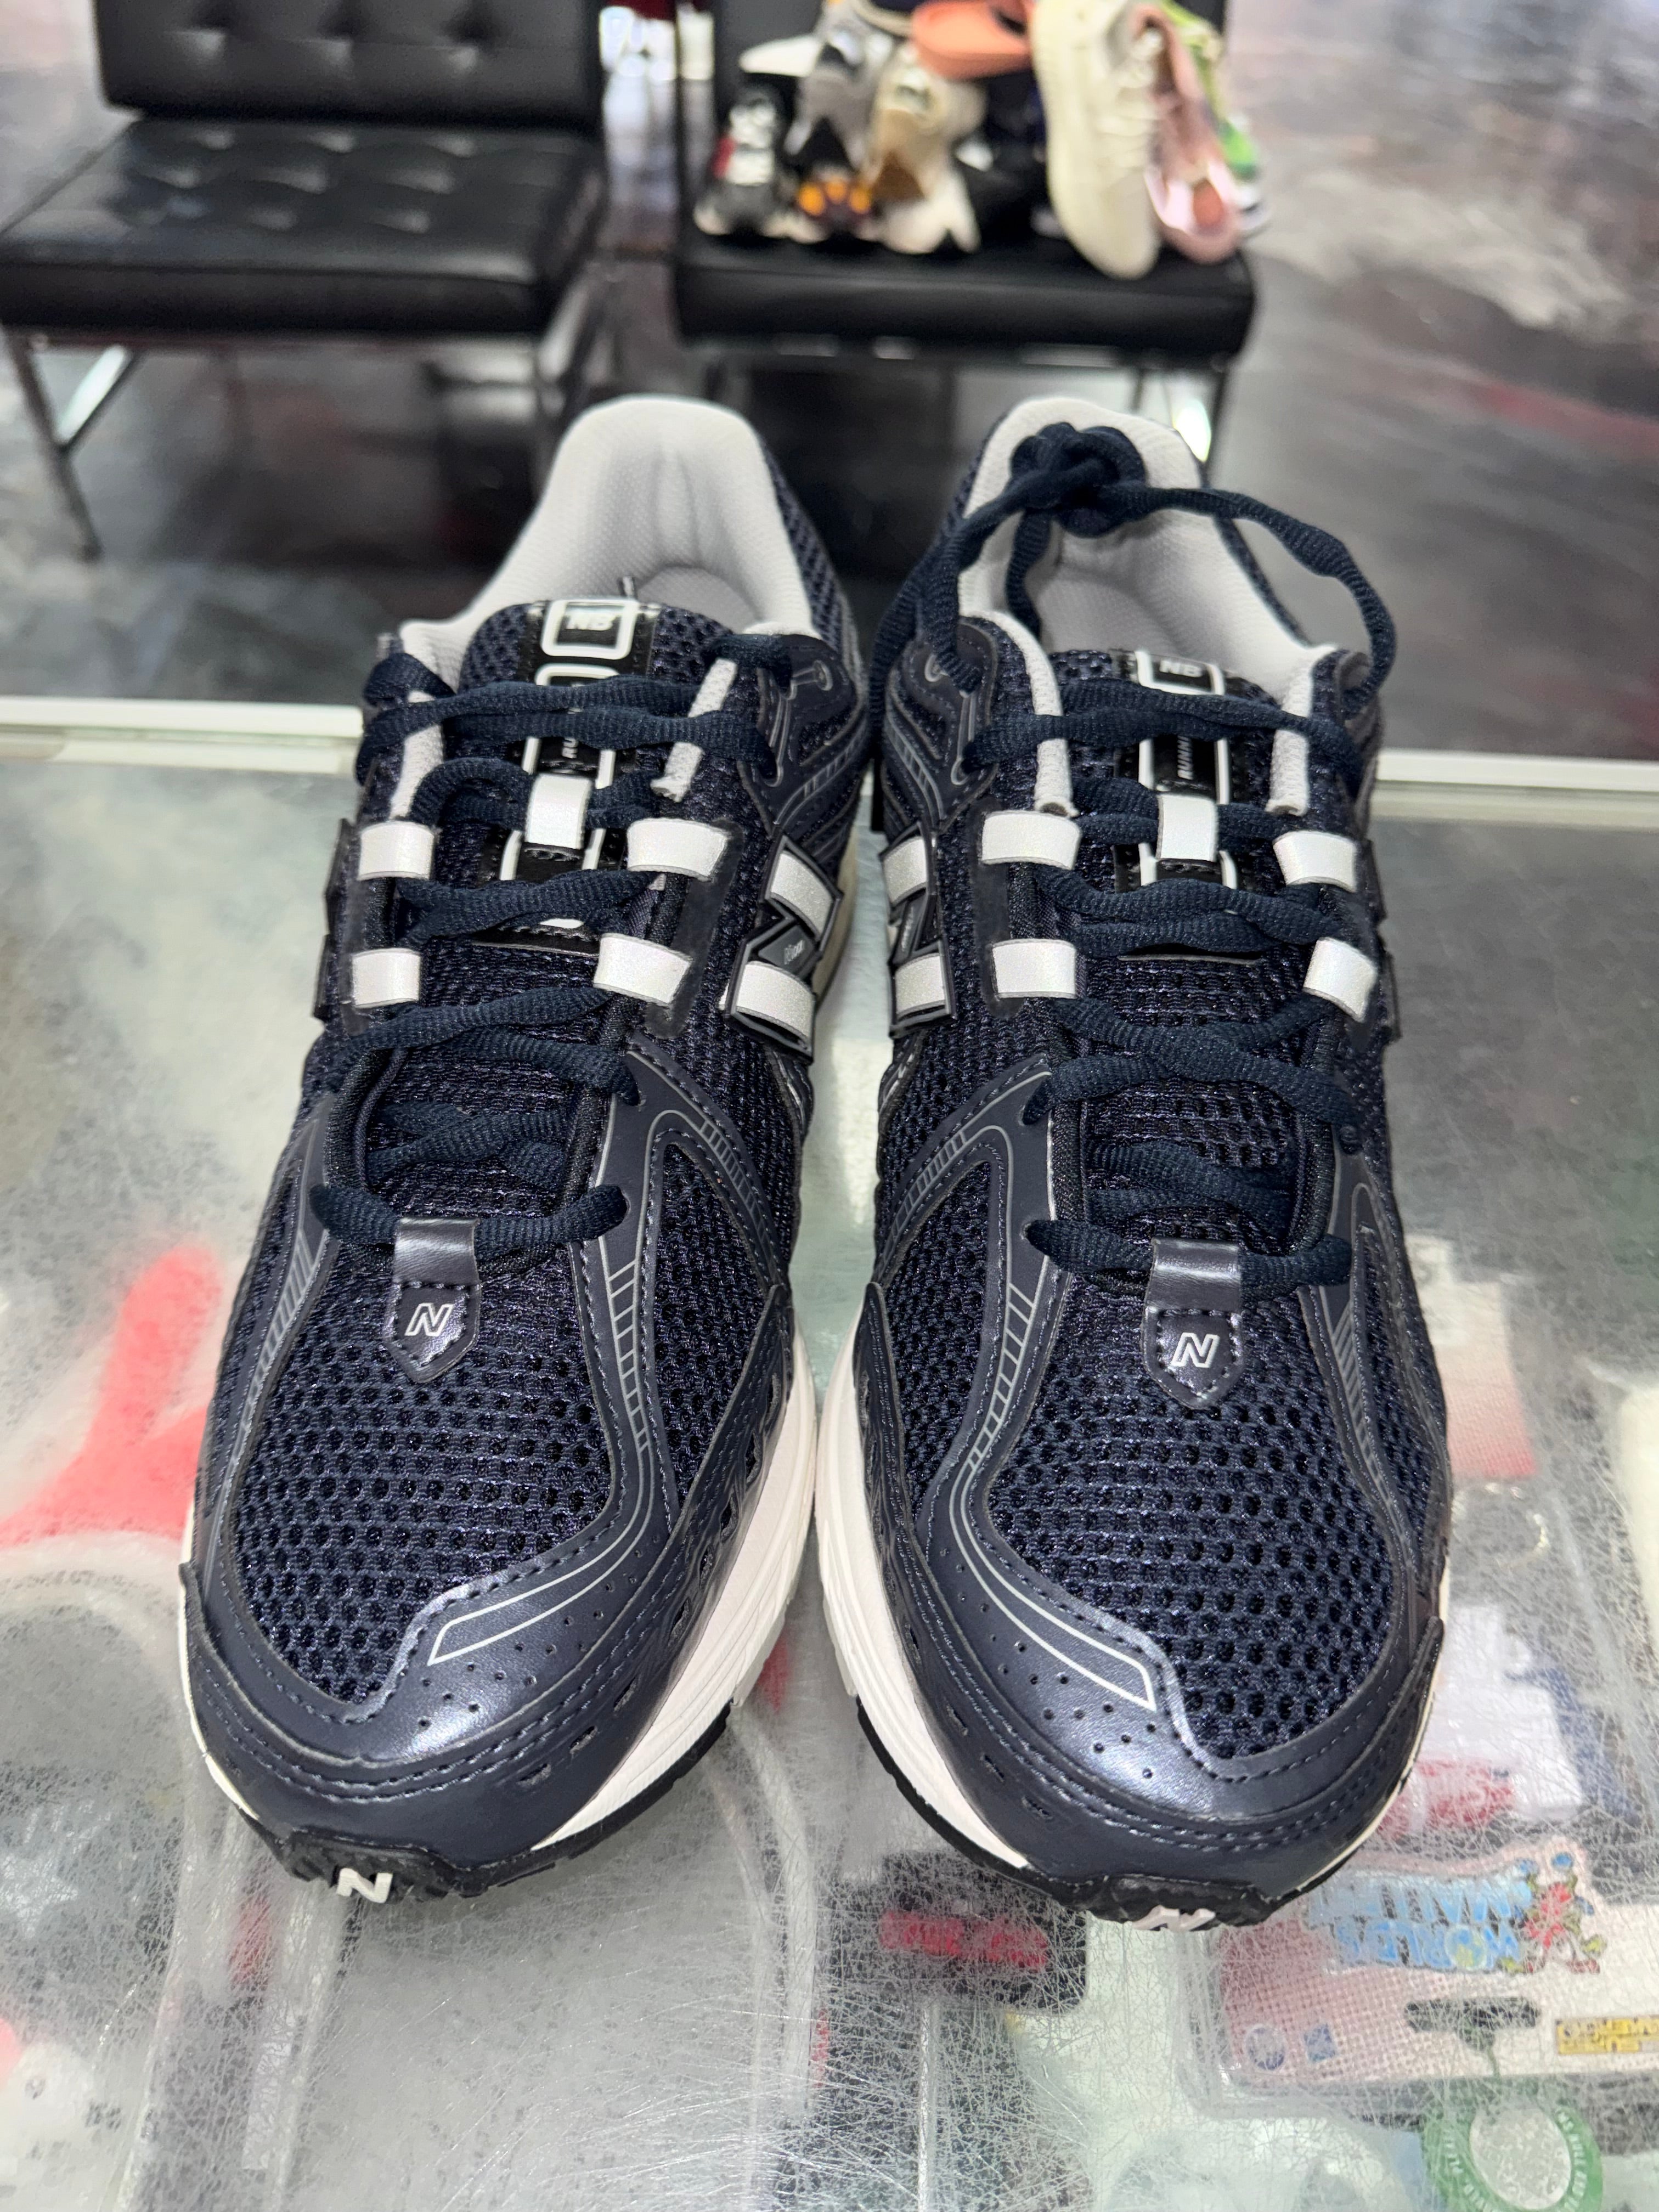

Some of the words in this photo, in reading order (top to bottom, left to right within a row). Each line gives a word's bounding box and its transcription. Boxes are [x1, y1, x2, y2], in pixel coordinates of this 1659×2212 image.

[1159, 659, 1203, 678] NB
[404, 1302, 454, 1337] N
[1170, 1332, 1220, 1368] N
[336, 1867, 393, 1904] N
